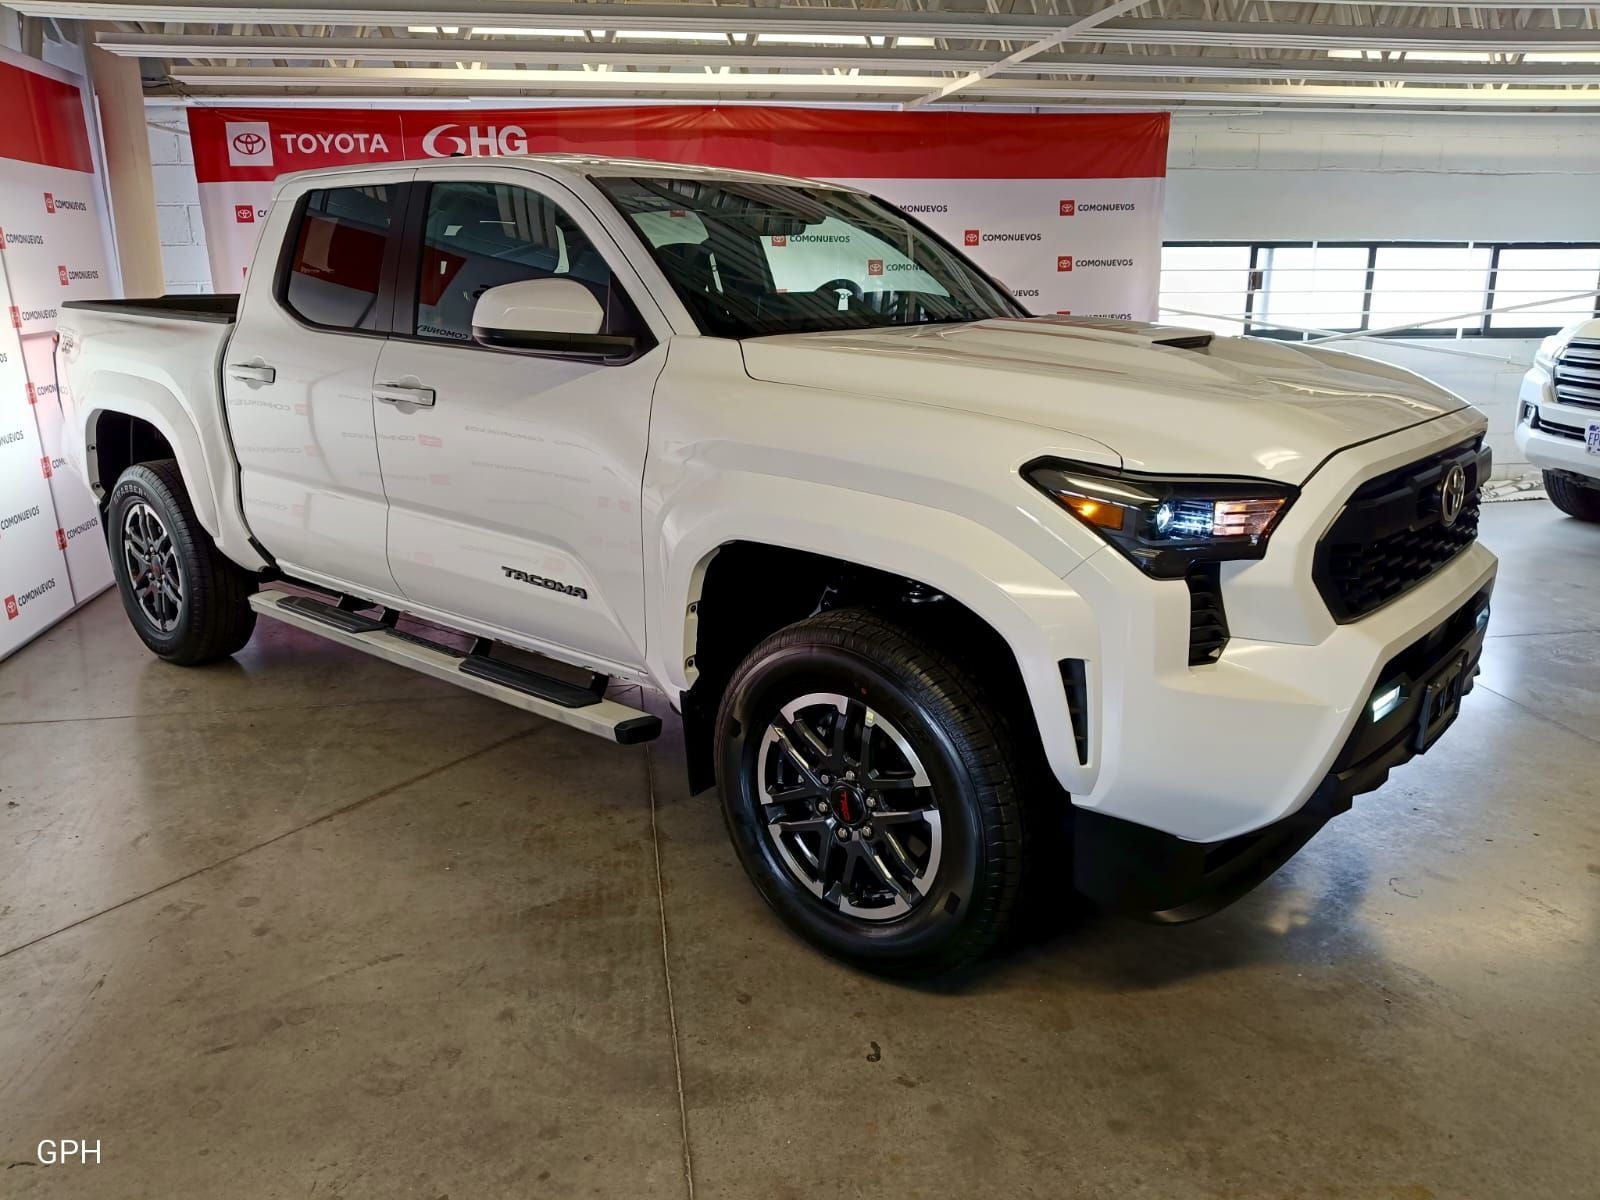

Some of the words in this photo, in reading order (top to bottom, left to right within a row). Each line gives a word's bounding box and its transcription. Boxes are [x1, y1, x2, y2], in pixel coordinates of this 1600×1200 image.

[280, 133, 389, 153] TOYOTA
[55, 199, 87, 211] COMONUEVOS
[900, 204, 948, 213] MONUEVOS
[1077, 203, 1135, 212] COMONUEVOS
[6, 233, 43, 245] COMONUEVOS
[789, 234, 851, 244] COMONUEVOS
[982, 233, 1042, 243] COMONUEVOS
[1075, 258, 1134, 268] COMONUEVOS
[68, 270, 99, 280] COMONUEVOS
[22, 308, 57, 321] COMONUEVOS
[1588, 431, 1600, 446] EP
[0, 505, 41, 530] COMONUEVOS
[66, 516, 99, 540] COMONUEVOS
[501, 565, 588, 600] TACOMA
[18, 577, 56, 607] COMONUEVOS
